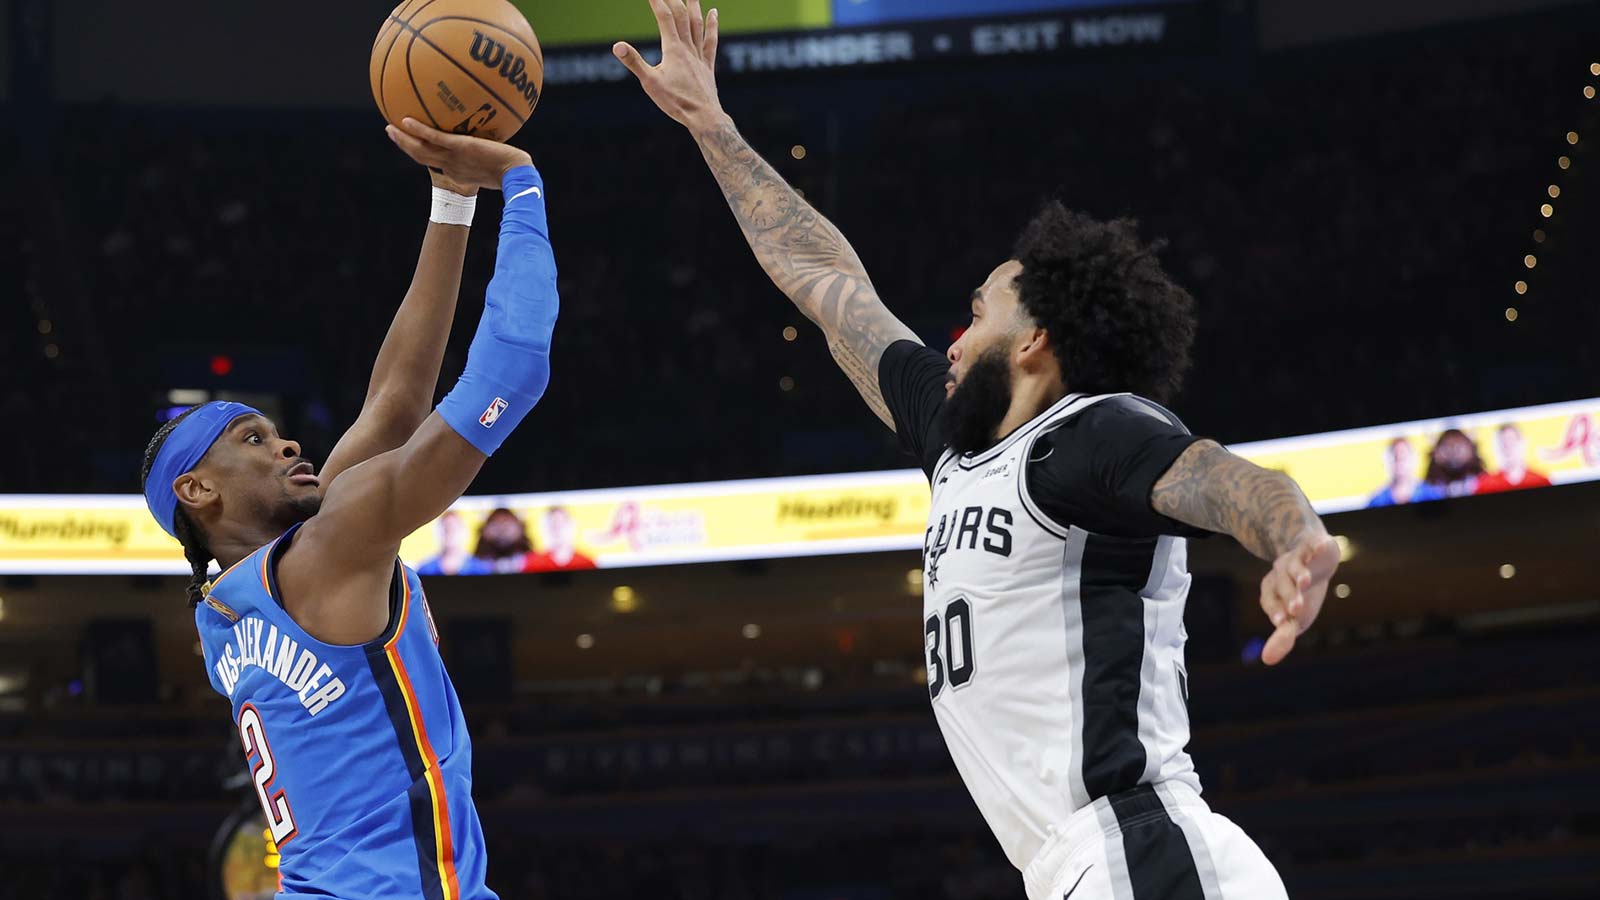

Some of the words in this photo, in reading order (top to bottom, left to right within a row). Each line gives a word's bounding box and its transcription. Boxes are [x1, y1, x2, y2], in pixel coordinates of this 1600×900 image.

[469, 29, 538, 112] Wilson
[727, 31, 914, 73] THUNDER
[971, 21, 1061, 55] EXIT
[1071, 14, 1165, 48] NOW
[777, 495, 899, 525] Heating
[238, 703, 299, 850] 2
